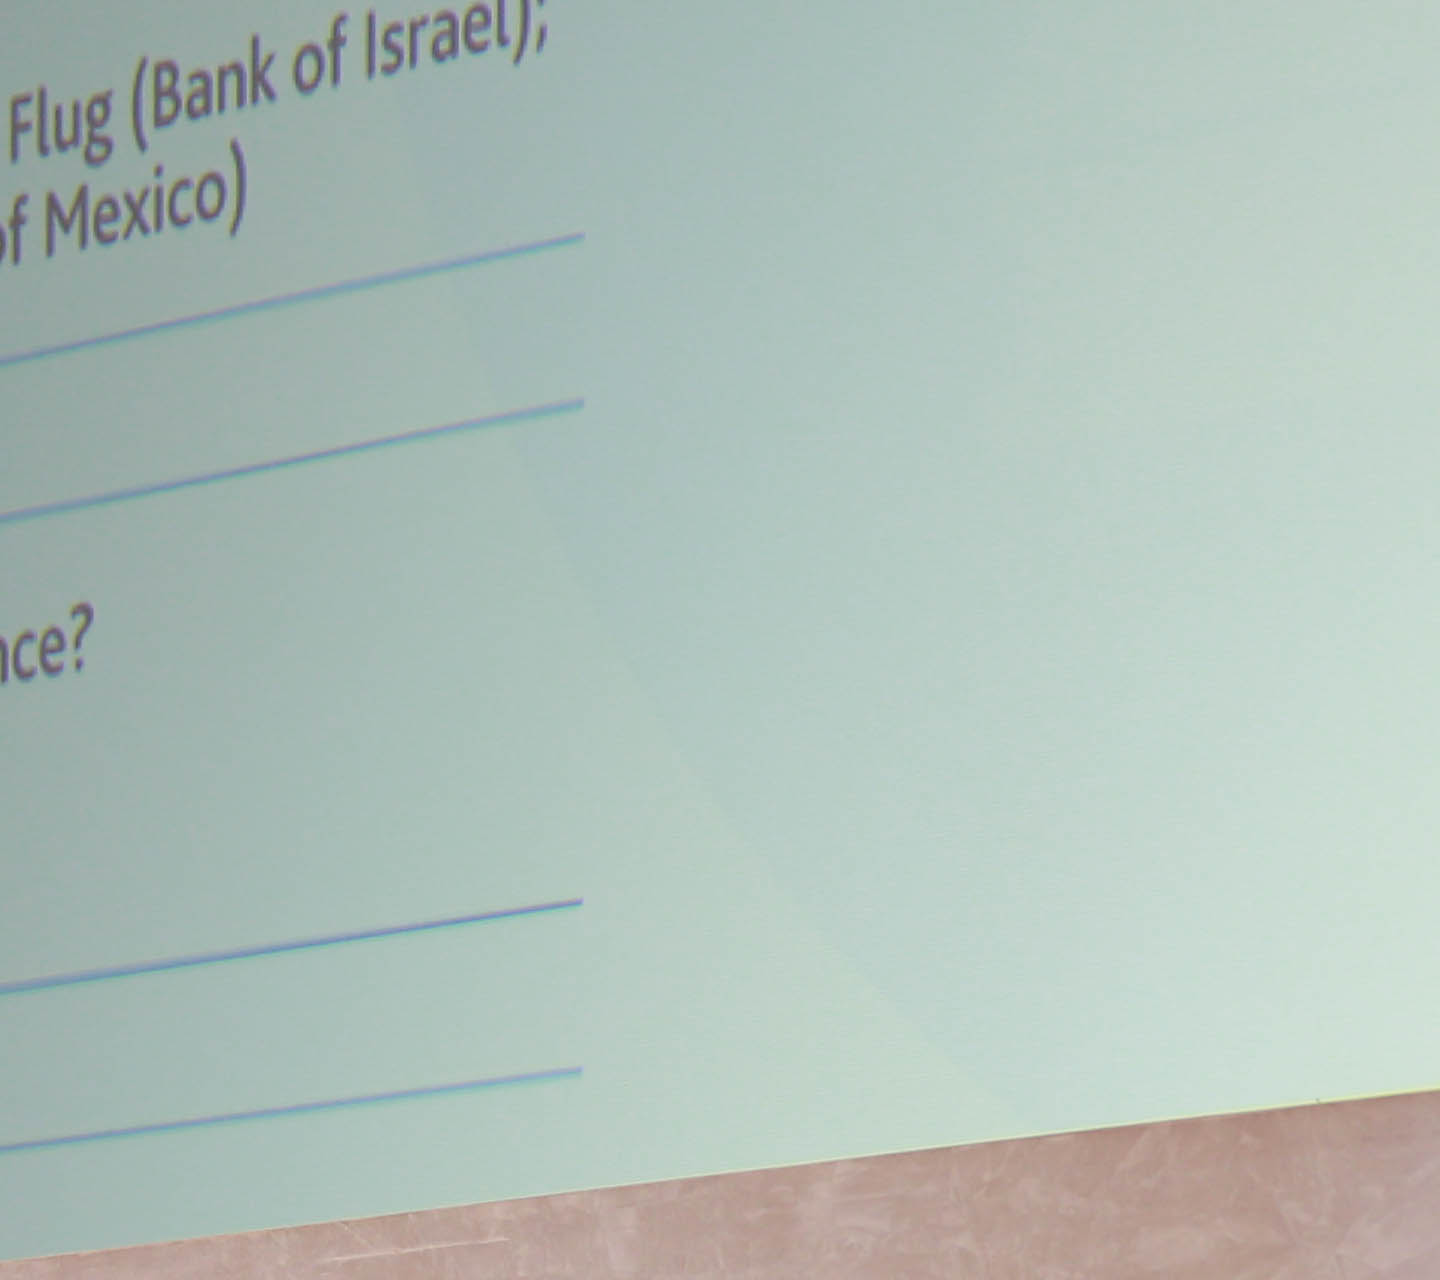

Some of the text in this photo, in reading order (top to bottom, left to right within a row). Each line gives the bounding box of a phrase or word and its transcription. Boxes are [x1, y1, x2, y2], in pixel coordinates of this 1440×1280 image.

[8, 84, 116, 170] Flug
[129, 32, 279, 155] (Bank
[290, 11, 351, 100] of
[363, 0, 550, 83] Israel);
[43, 137, 249, 261] Mexico)
